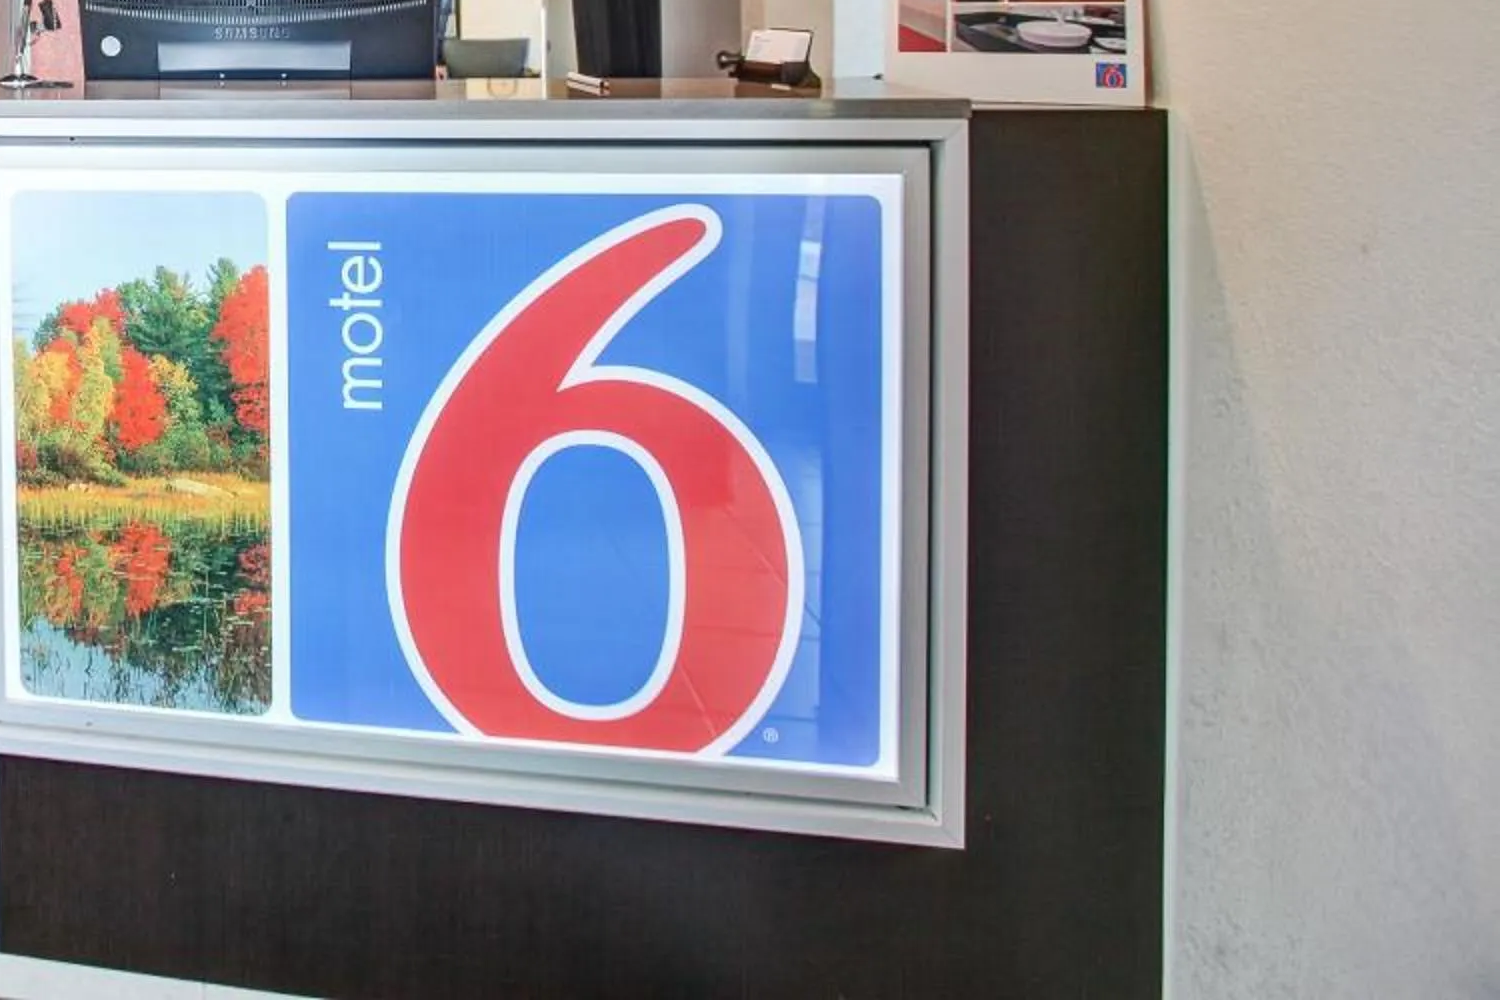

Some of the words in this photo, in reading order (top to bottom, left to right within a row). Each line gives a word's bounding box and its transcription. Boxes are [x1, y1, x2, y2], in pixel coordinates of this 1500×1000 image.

[214, 26, 290, 40] SAMSUNG
[327, 240, 383, 410] motel
[385, 203, 805, 757] 6
